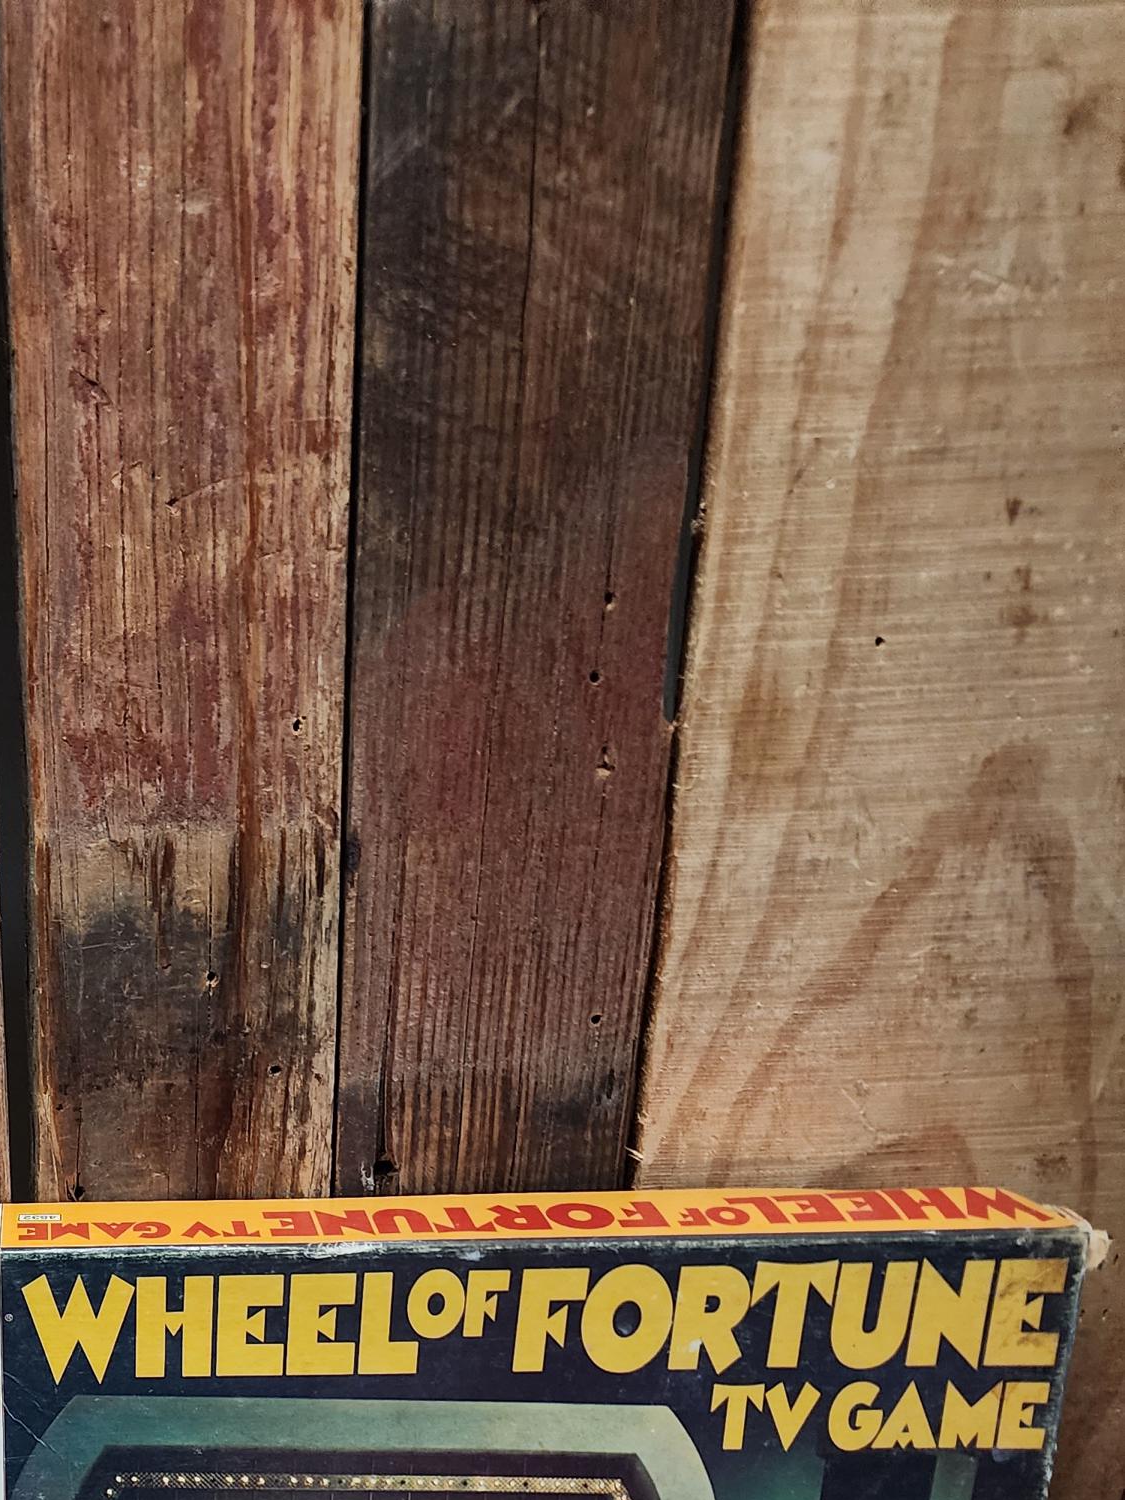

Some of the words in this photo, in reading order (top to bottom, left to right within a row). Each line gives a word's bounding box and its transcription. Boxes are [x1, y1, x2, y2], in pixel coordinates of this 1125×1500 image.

[263, 1202, 671, 1236] FORTUNE
[679, 1204, 749, 1226] OF
[744, 1187, 1051, 1223] WHEEL
[17, 1220, 171, 1241] GAME
[181, 1218, 263, 1237] TV
[20, 1271, 420, 1386] WHEEL
[407, 1268, 511, 1339] OF
[511, 1258, 1069, 1374] FORTUNE
[710, 1380, 821, 1453] TV
[827, 1379, 1051, 1452] GAME
